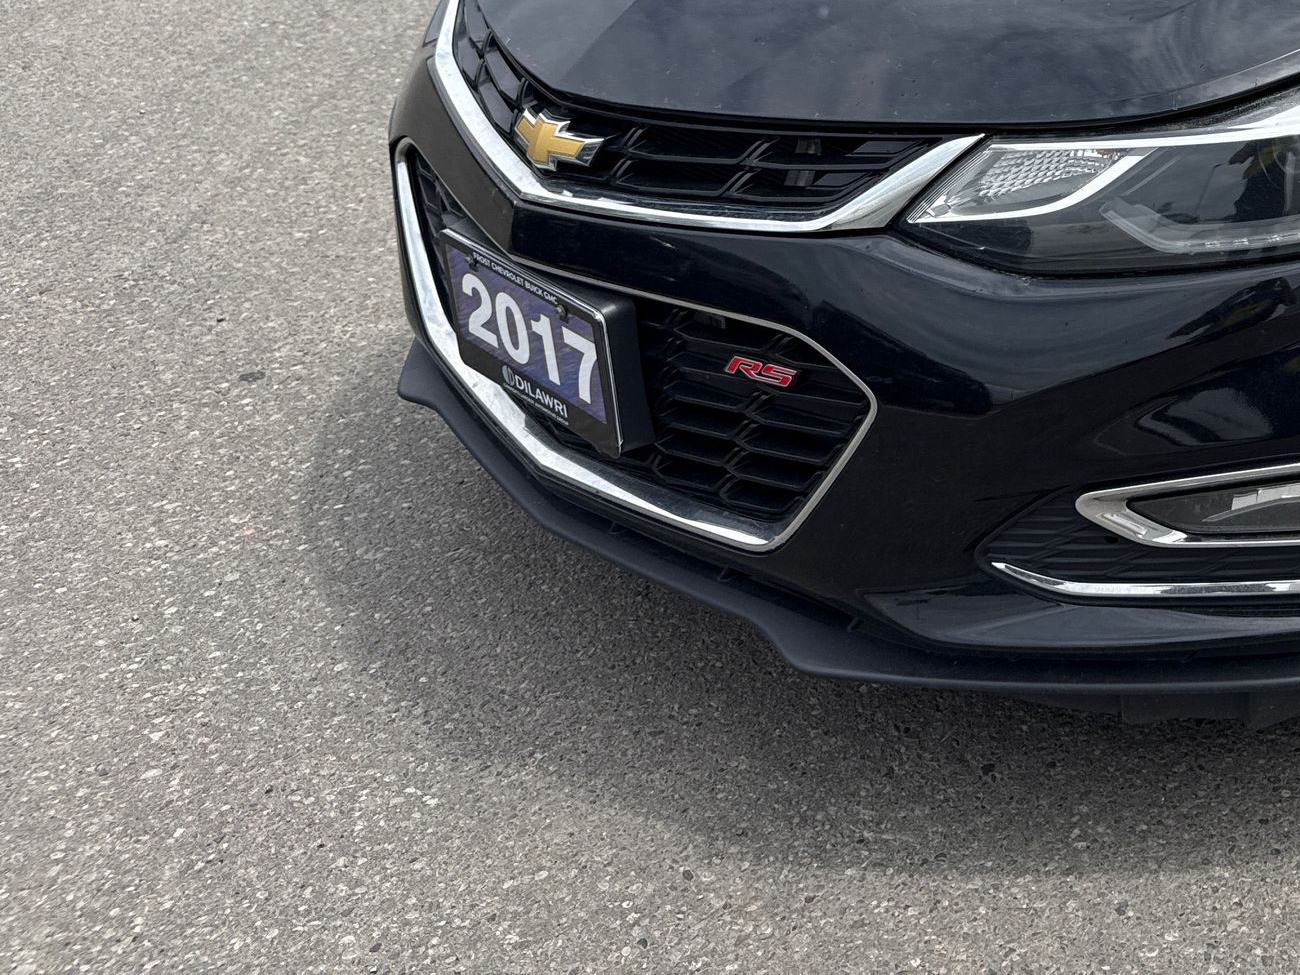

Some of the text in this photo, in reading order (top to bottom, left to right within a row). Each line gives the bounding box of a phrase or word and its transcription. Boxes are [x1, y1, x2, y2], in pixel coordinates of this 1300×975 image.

[491, 262, 524, 286] CHEVROLET
[525, 280, 543, 297] BUICK
[461, 273, 598, 405] 2017
[725, 355, 798, 388] RS
[514, 374, 569, 418] DILAWRI
